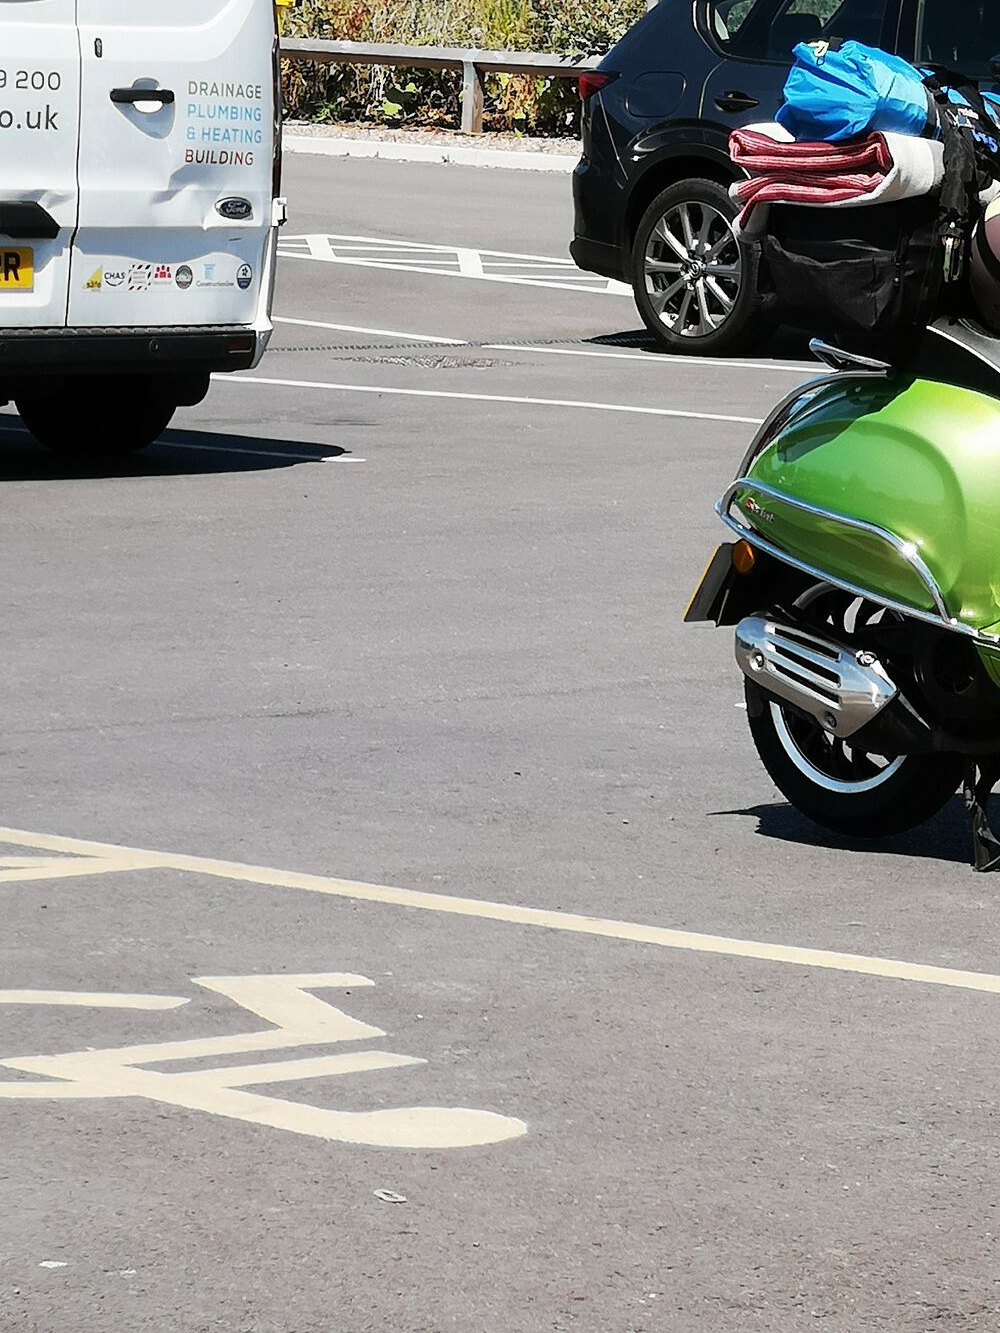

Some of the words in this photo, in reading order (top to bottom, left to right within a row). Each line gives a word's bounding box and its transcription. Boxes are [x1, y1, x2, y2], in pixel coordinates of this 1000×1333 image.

[15, 70, 61, 91] 200
[188, 80, 262, 99] DRAINAGE
[187, 103, 262, 122] PLUMBING
[186, 126, 196, 140] &
[201, 127, 262, 144] HEATING
[185, 149, 254, 166] BUILDING
[0, 252, 21, 282] R
[104, 271, 126, 280] CHAS
